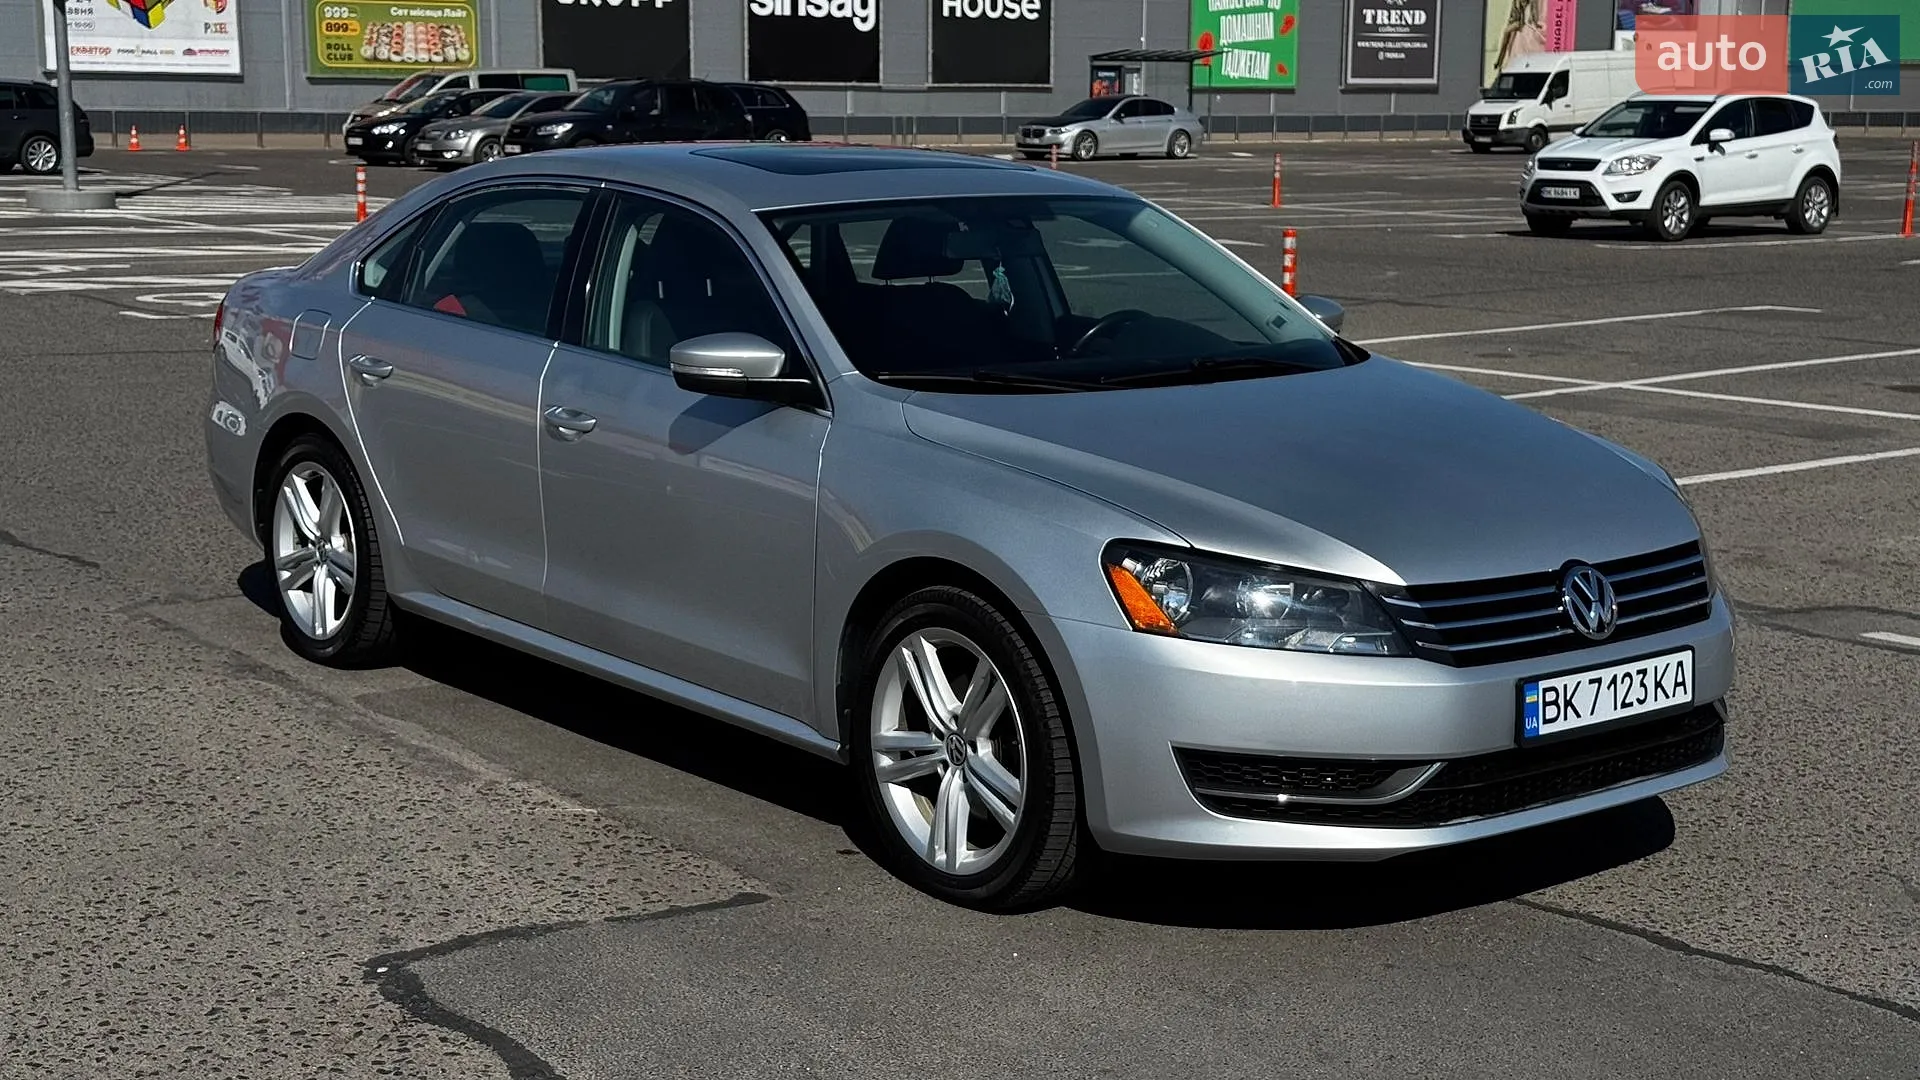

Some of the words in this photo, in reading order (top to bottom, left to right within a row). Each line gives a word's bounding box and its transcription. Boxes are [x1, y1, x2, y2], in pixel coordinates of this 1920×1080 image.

[1363, 9, 1427, 25] TREND
[325, 22, 349, 32] 899
[326, 43, 353, 51] ROLL
[326, 53, 353, 61] CLUB
[1542, 680, 1582, 725] BK
[1588, 667, 1649, 717] 7123
[1654, 659, 1688, 702] KA
[1525, 720, 1538, 730] UA
